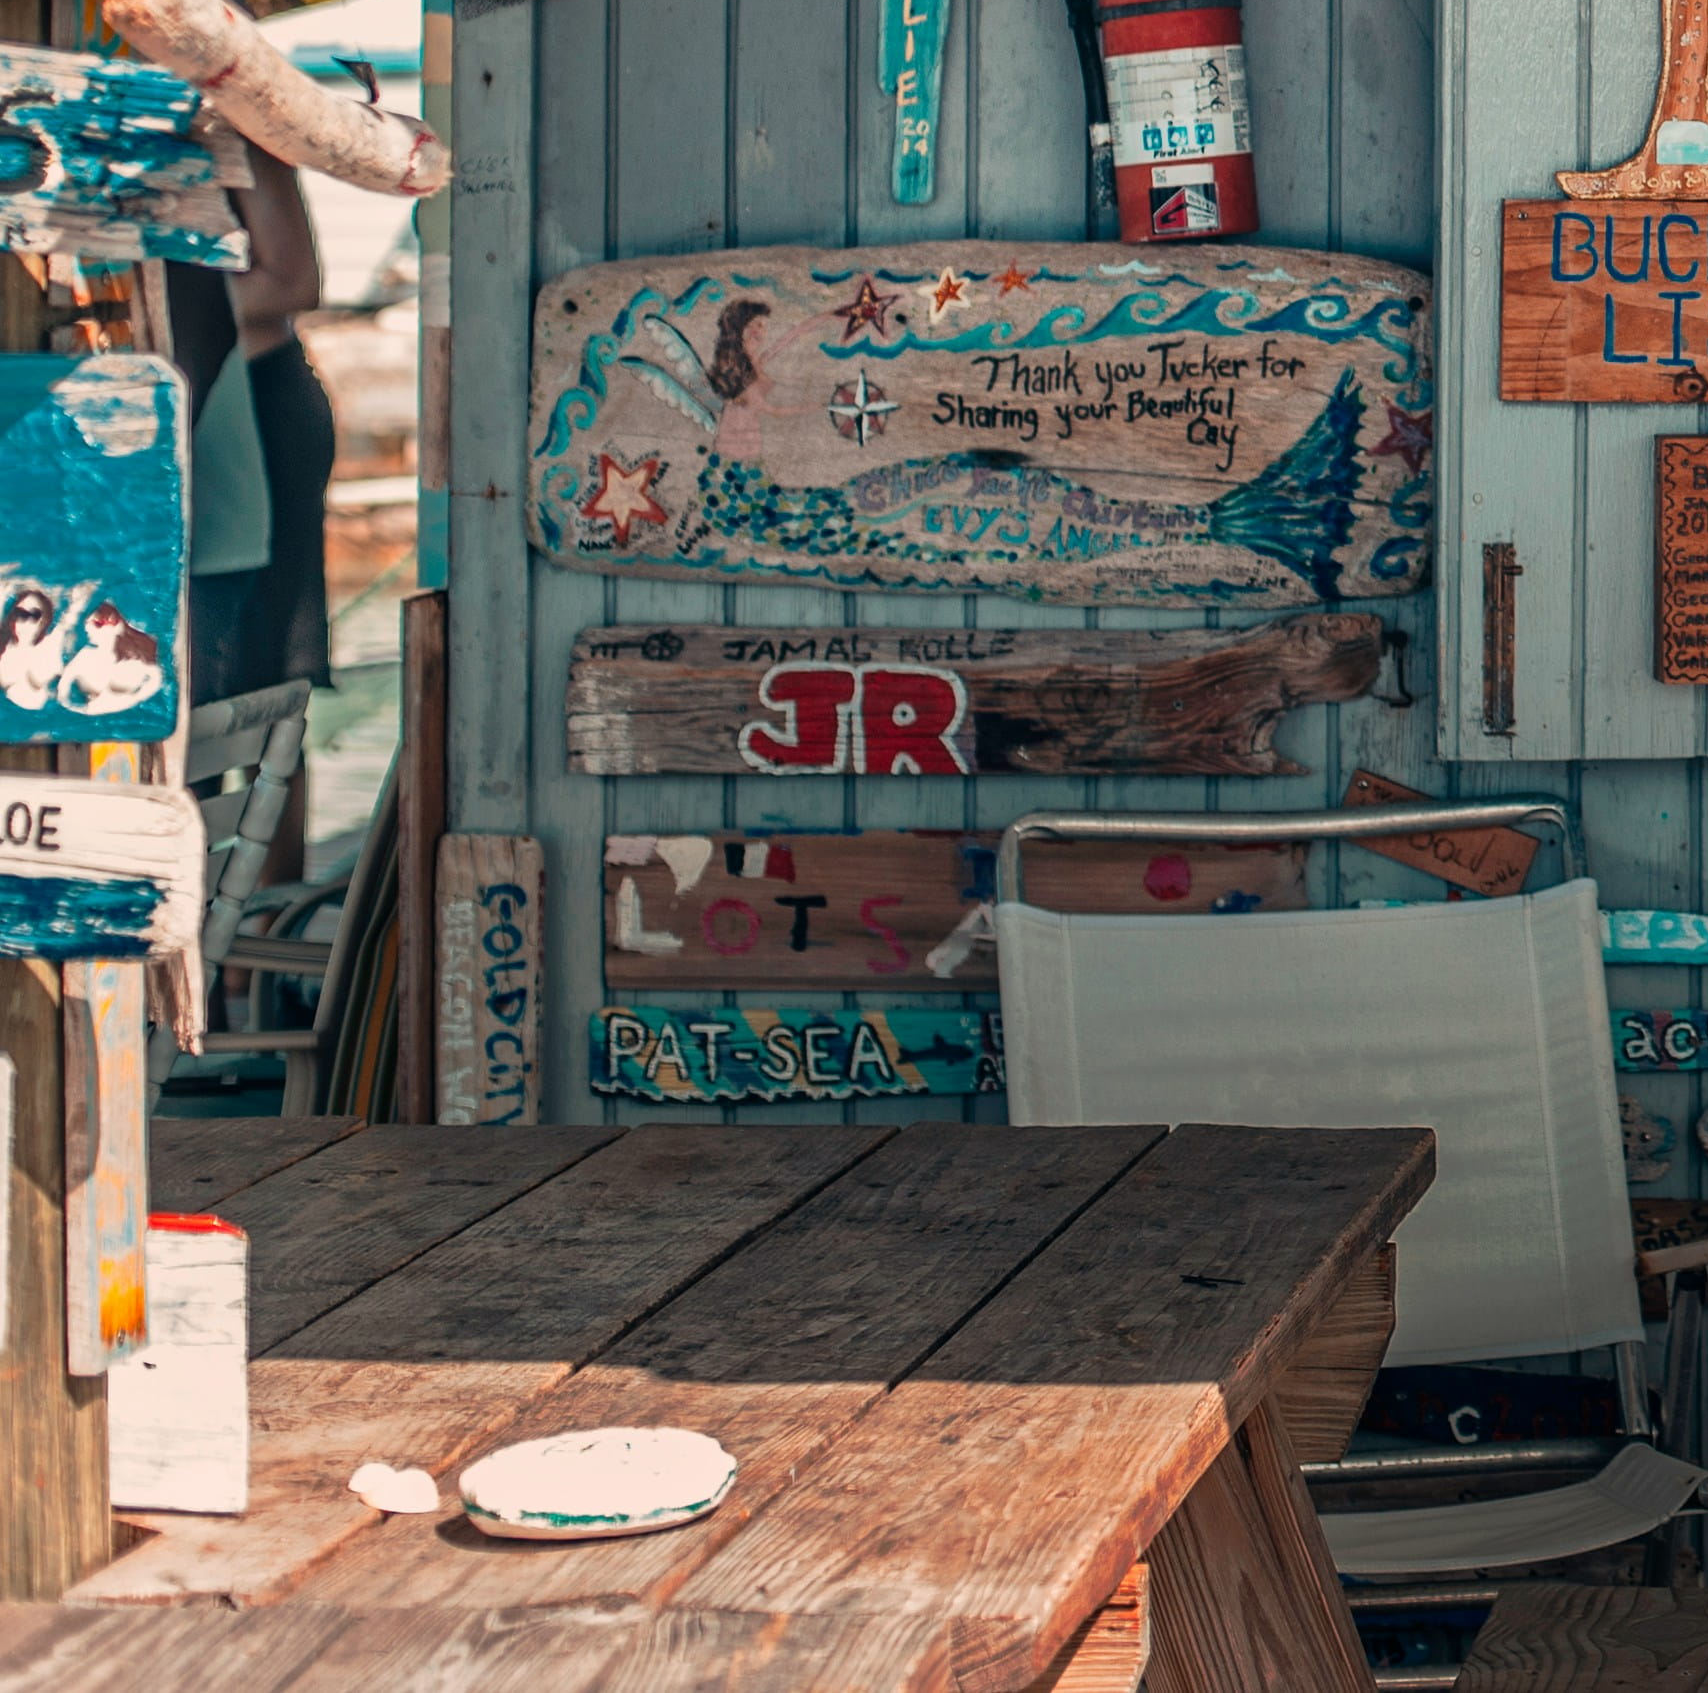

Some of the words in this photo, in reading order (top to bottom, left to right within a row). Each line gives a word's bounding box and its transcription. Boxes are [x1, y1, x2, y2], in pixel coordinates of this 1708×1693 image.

[974, 349, 1081, 399] Thank
[1097, 352, 1147, 403] you
[1150, 340, 1248, 386] Tucker
[1256, 339, 1307, 385] for
[933, 392, 1040, 446] Sharing
[1056, 401, 1121, 446] your
[1126, 389, 1237, 425] Beautiful
[737, 662, 969, 775] JR
[607, 1014, 895, 1084] PAT-SEA
